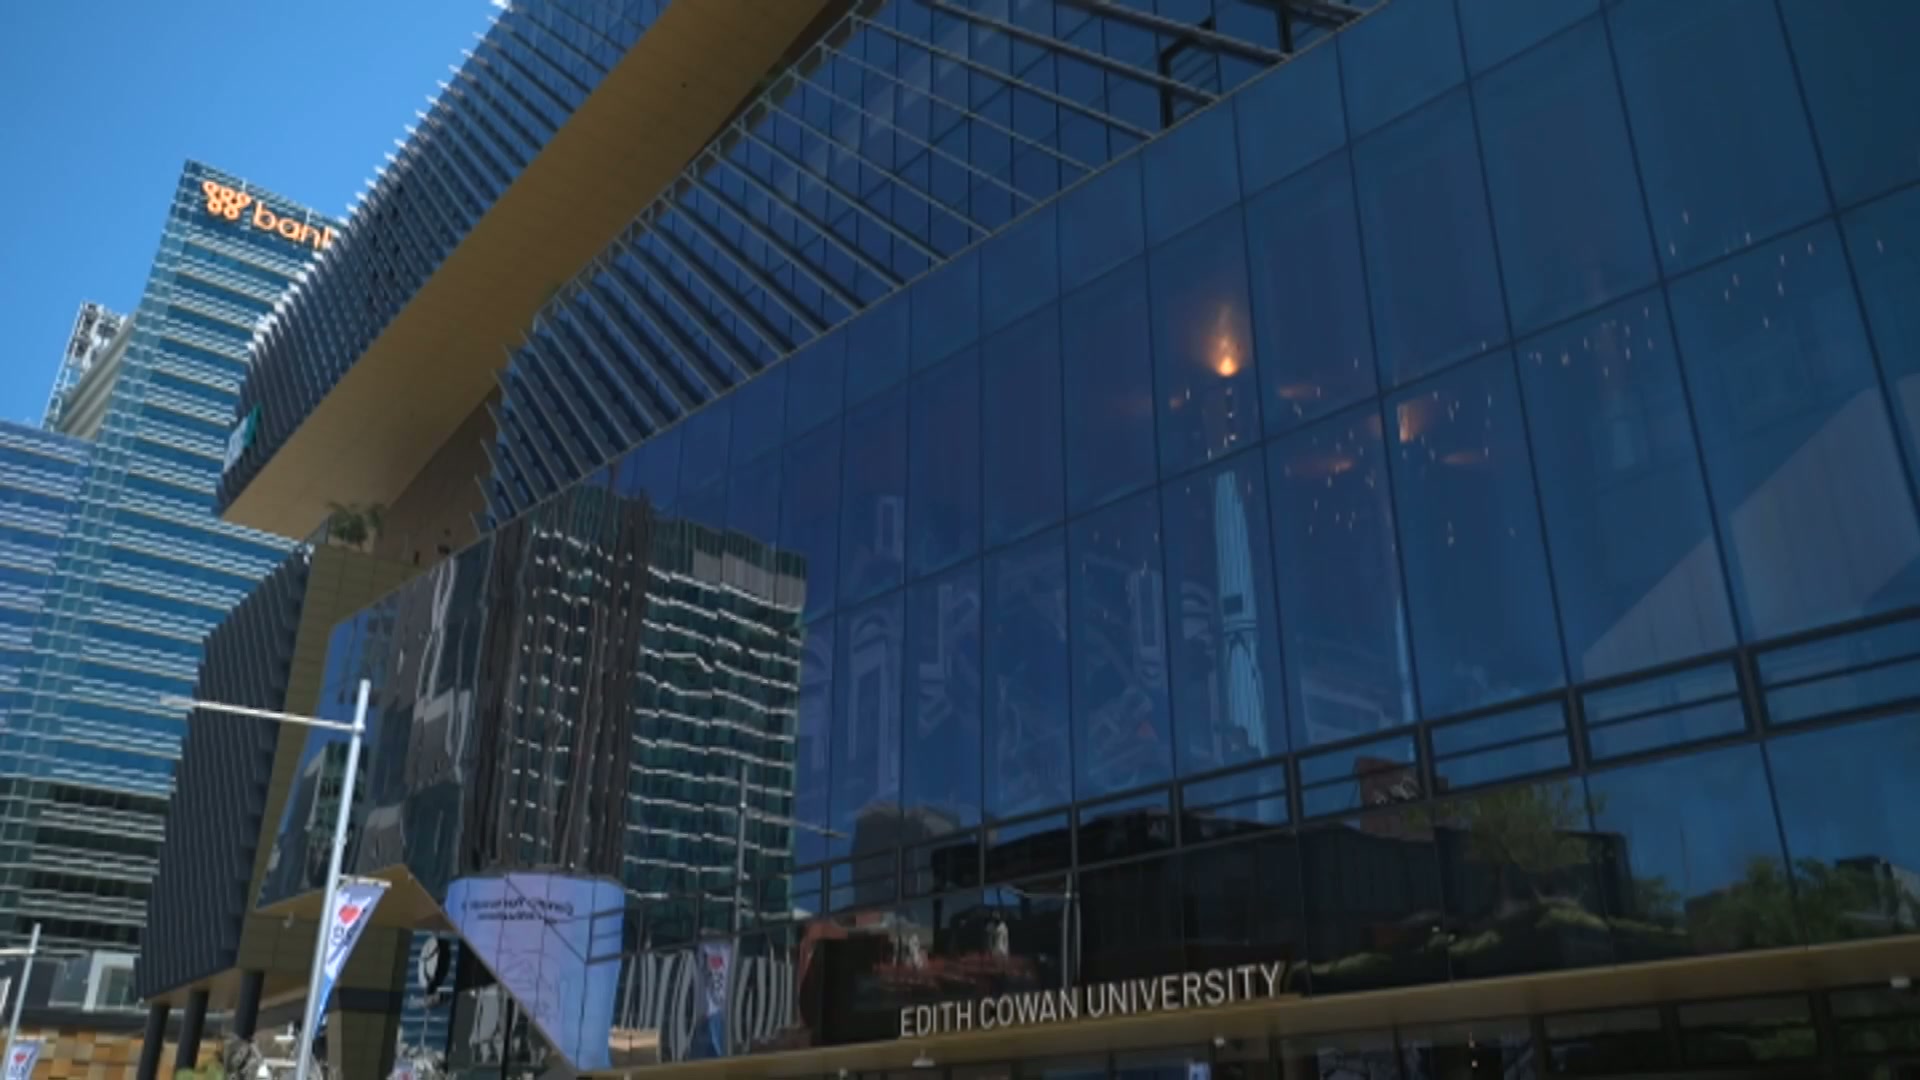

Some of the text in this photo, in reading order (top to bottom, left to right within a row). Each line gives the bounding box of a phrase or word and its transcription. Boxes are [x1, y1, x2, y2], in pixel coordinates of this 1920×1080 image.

[900, 961, 1284, 1038] EDITH COWAN UNIVERSITY
